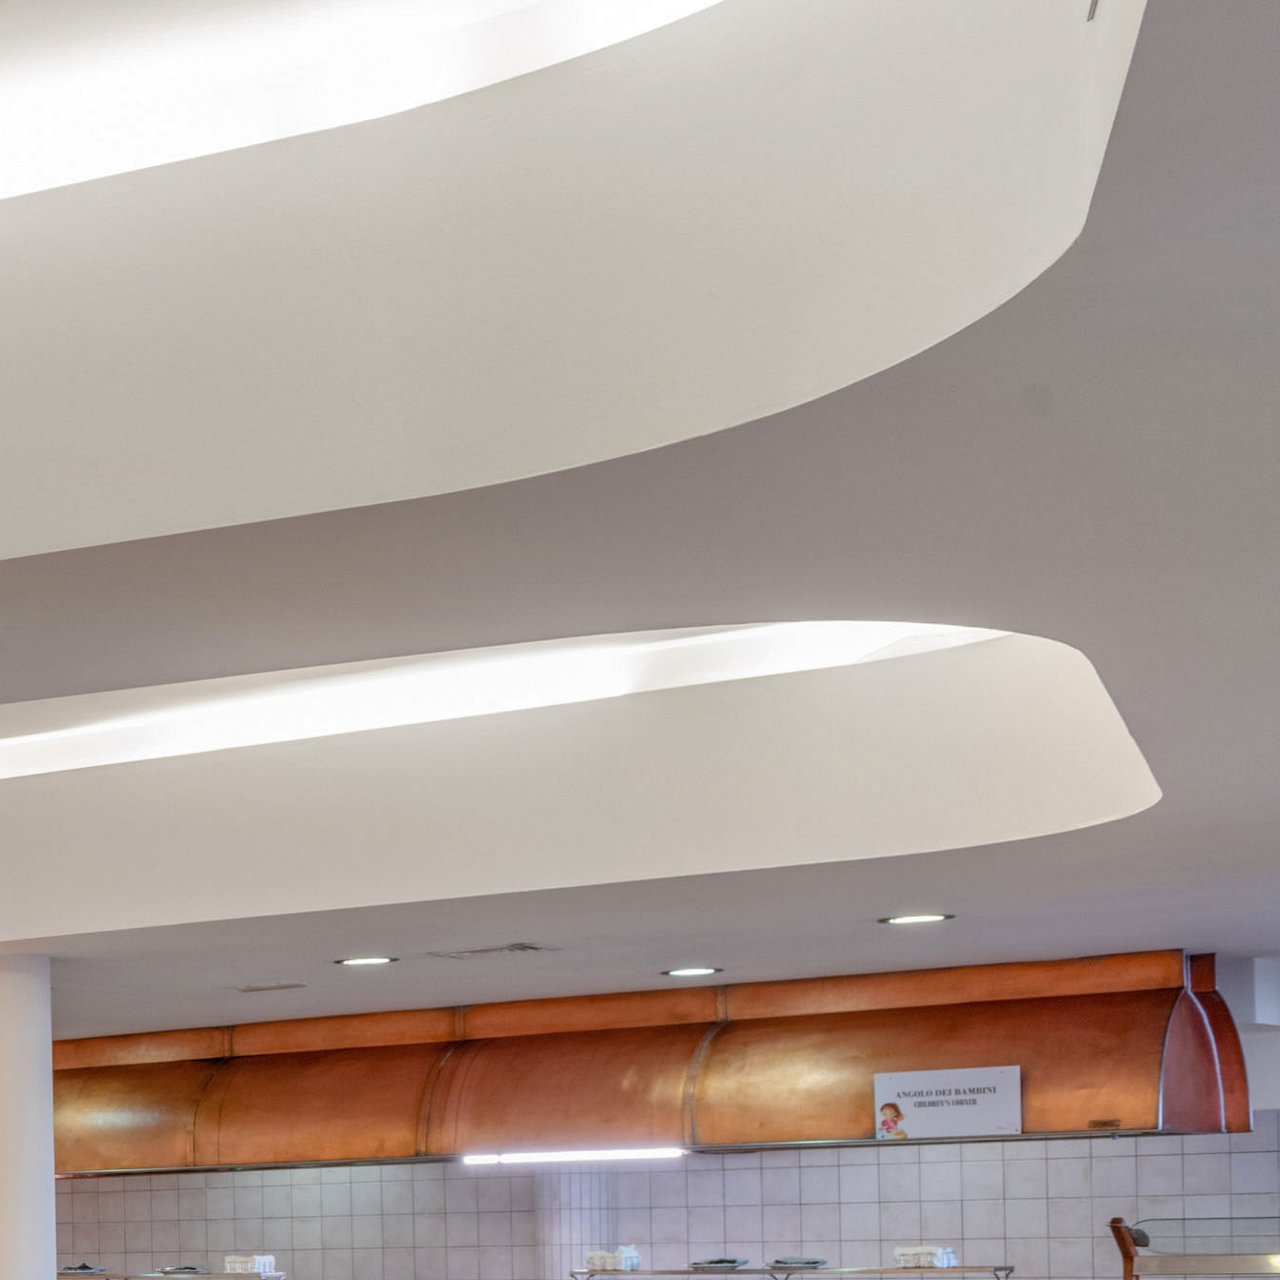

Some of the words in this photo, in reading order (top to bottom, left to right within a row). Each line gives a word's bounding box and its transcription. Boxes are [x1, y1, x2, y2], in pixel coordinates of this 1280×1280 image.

[896, 1090, 933, 1099] ANGOLO
[935, 1088, 952, 1097] DEI
[954, 1086, 997, 1096] BAMBINI
